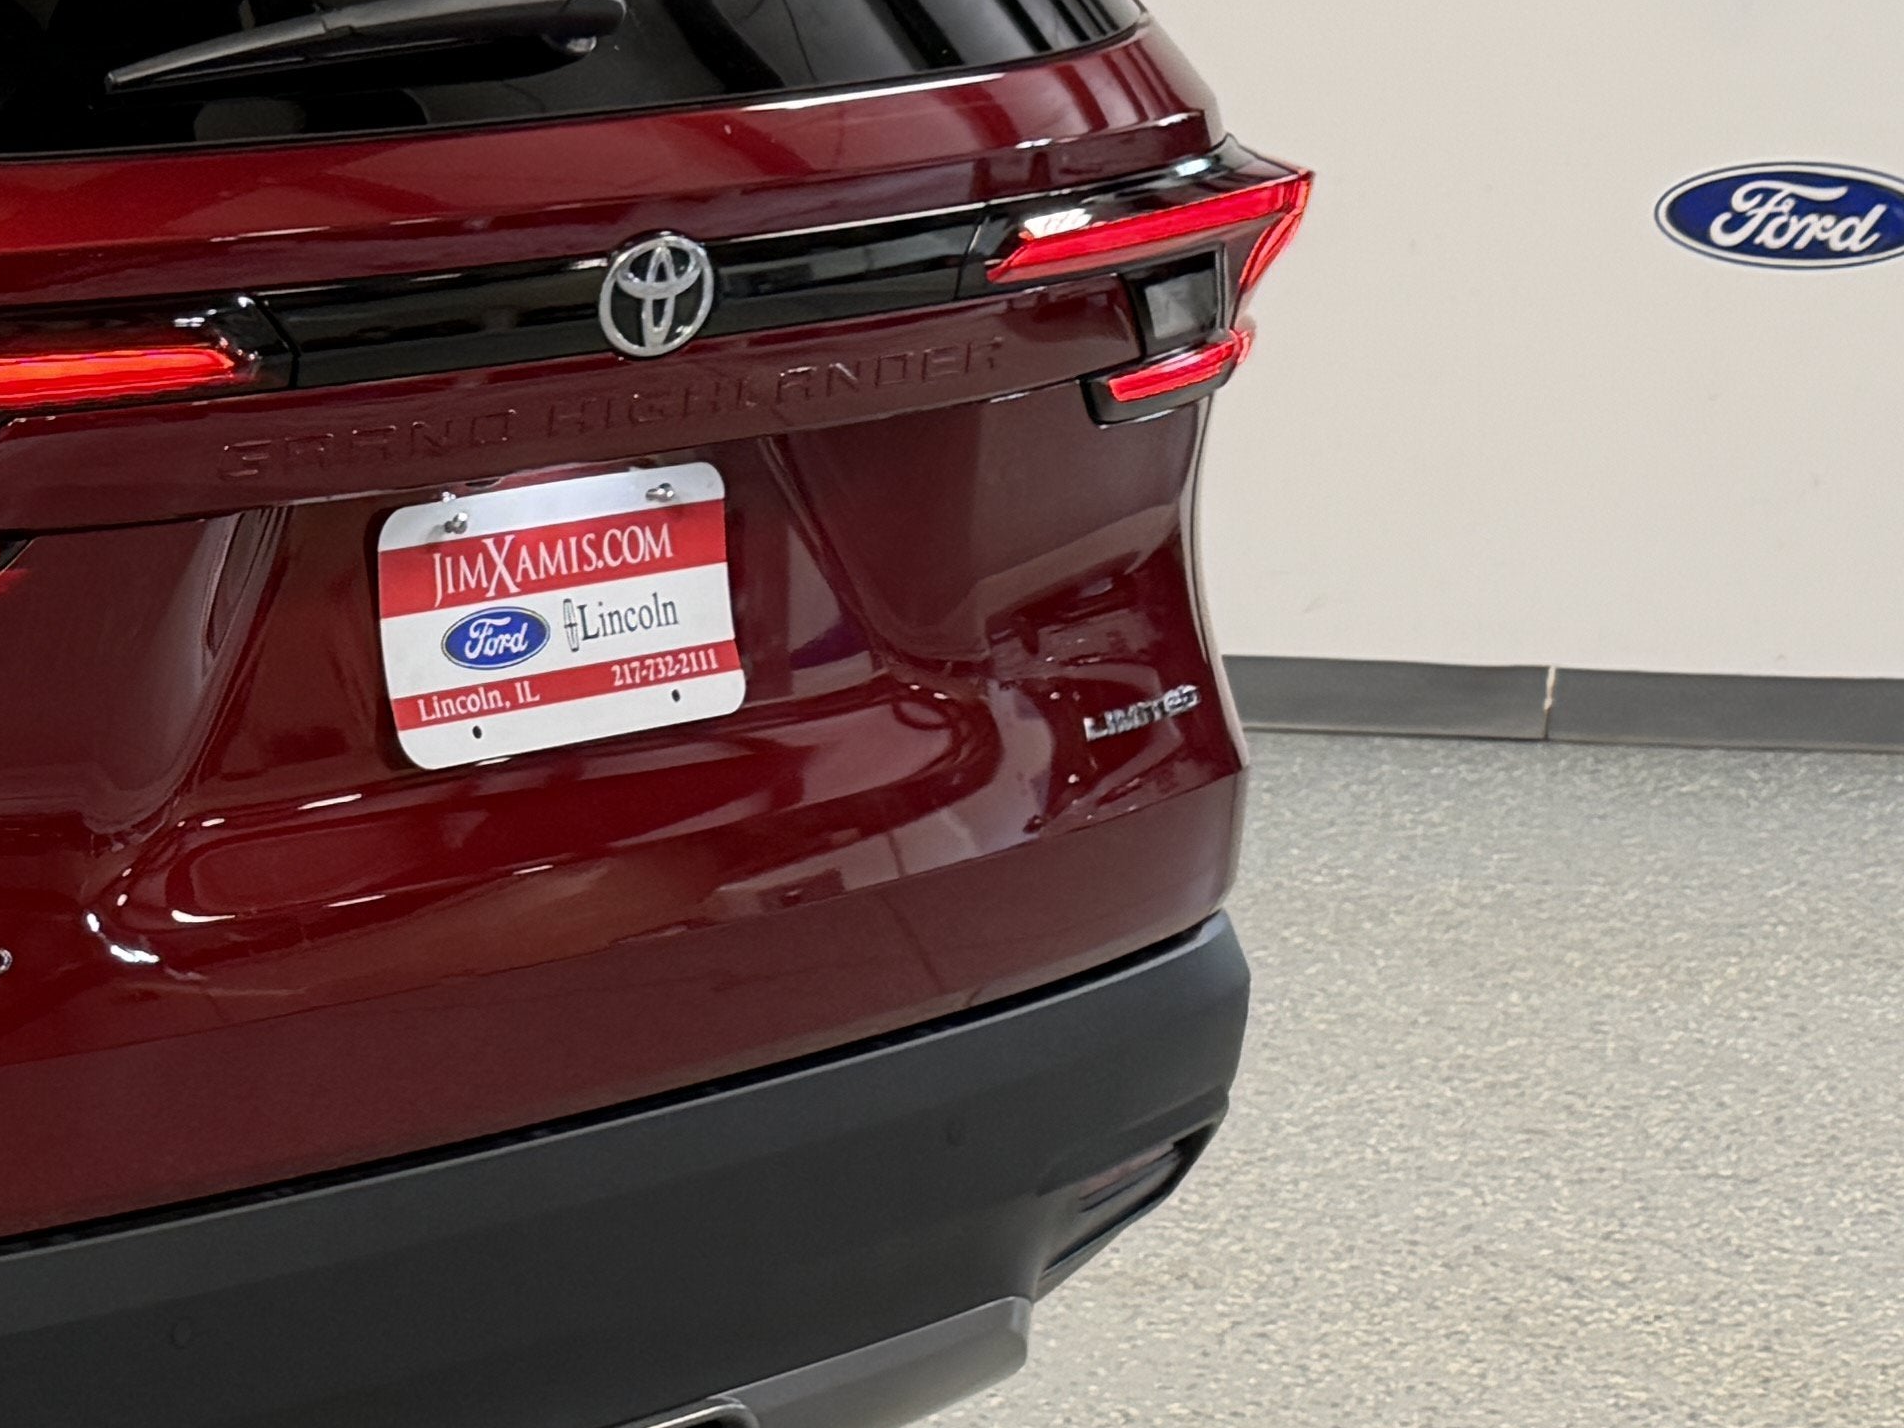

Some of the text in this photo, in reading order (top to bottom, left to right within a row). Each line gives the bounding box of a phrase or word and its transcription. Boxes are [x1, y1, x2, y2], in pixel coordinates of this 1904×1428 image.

[1710, 180, 1887, 253] Ford
[215, 335, 1005, 478] GRAND HIGHLANDER
[433, 523, 674, 608] JIMXAMIS.COM
[464, 617, 529, 662] Ford
[577, 592, 680, 643] Lincoln
[611, 648, 719, 687] 217-732-2111
[418, 681, 540, 723] Lincoln, IL
